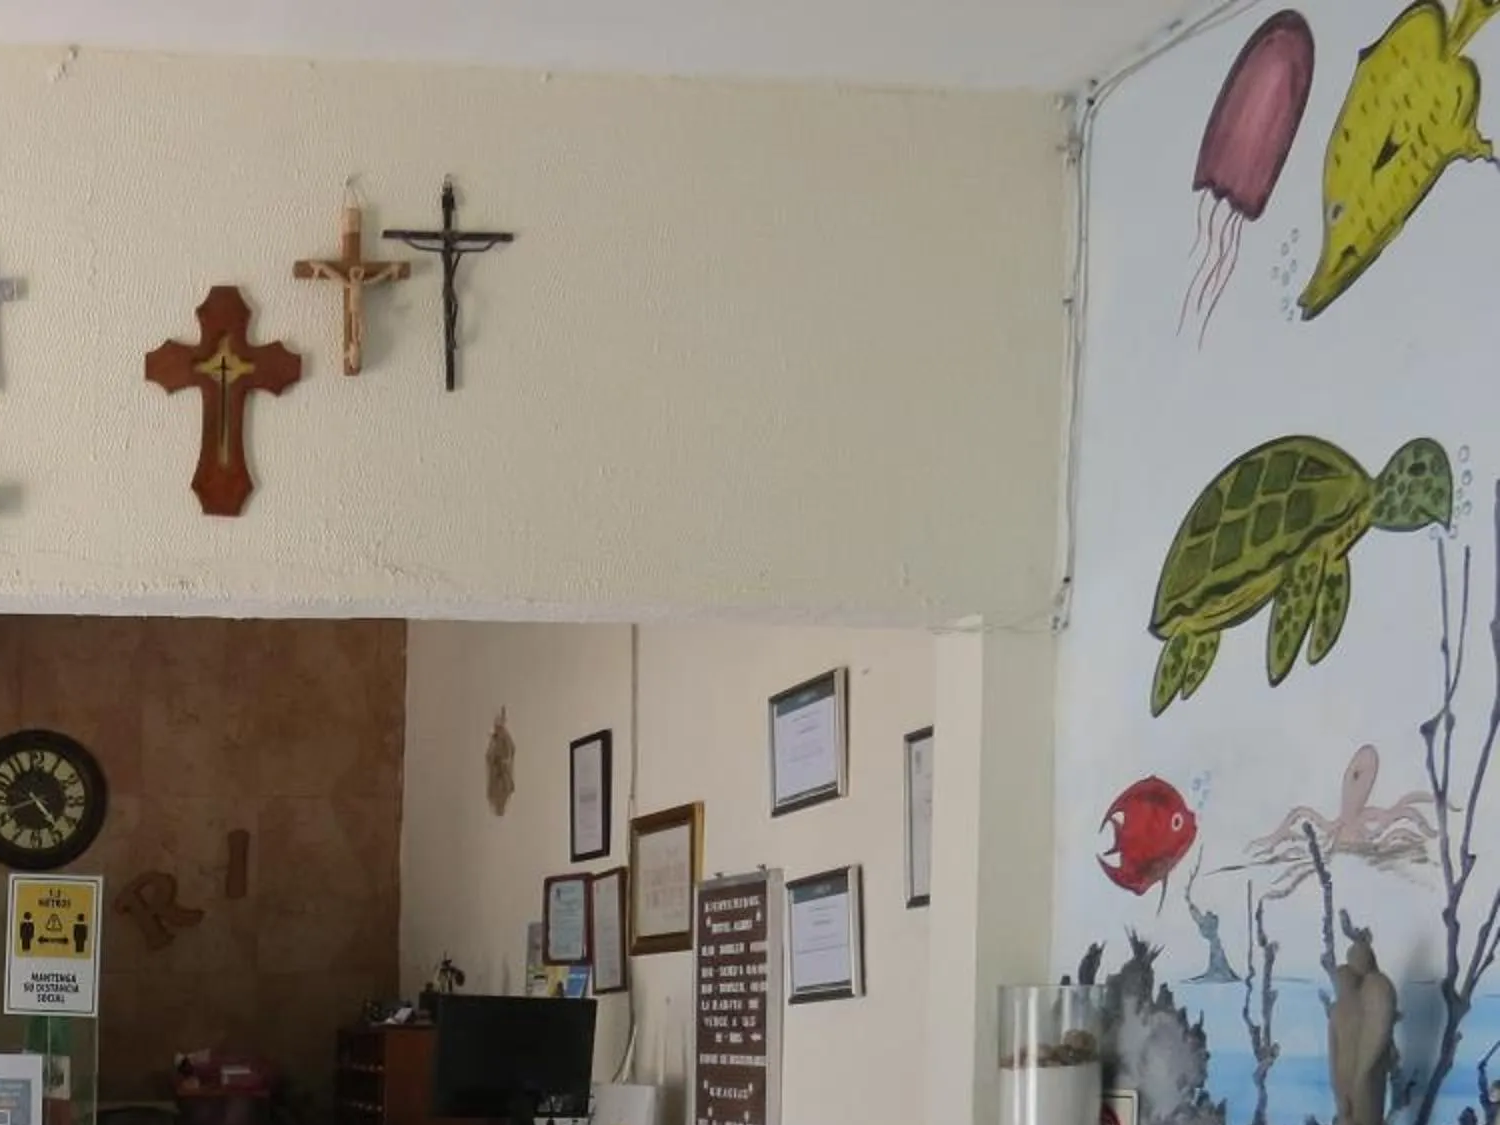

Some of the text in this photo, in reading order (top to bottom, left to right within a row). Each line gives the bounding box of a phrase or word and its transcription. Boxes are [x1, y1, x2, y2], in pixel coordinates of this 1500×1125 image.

[31, 972, 77, 983] MANTENGA
[35, 983, 80, 994] DISTANCIA
[37, 993, 66, 1005] SOCIAL
